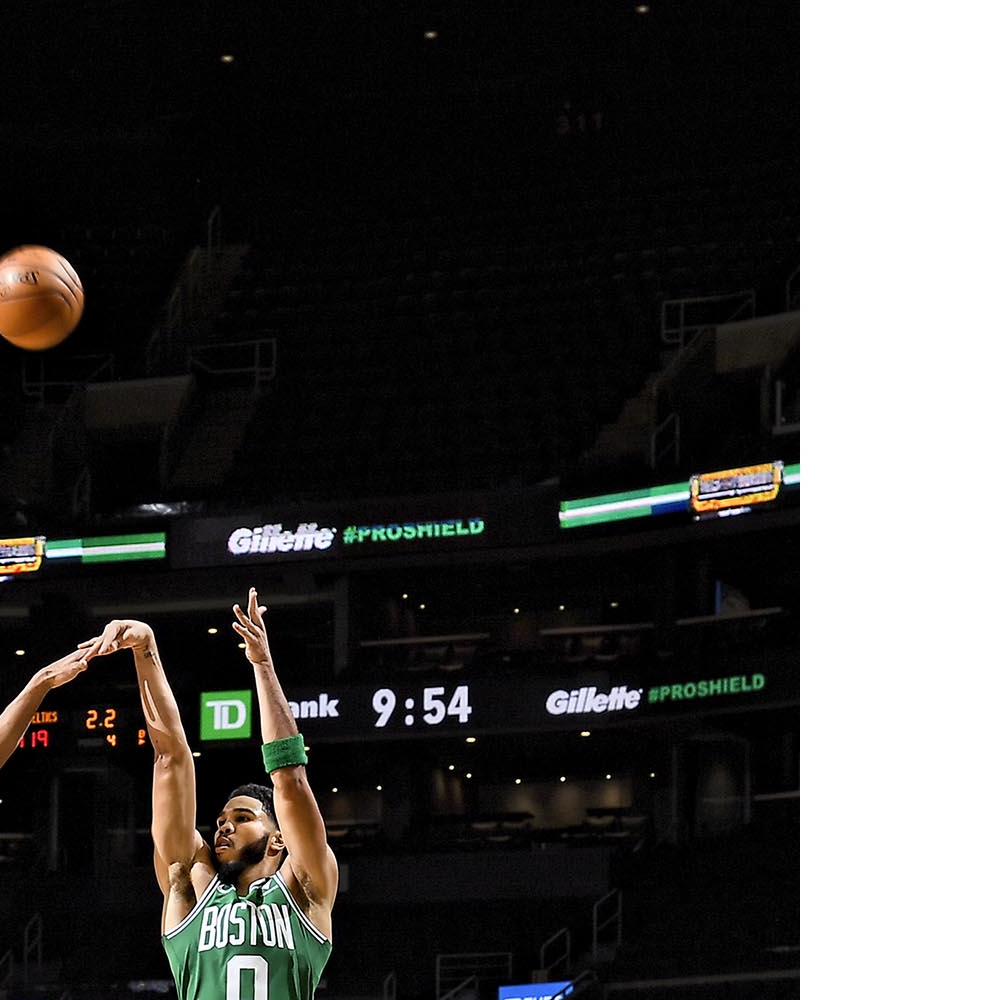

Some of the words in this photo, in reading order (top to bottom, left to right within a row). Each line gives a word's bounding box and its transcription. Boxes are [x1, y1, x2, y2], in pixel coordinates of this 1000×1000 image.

[228, 523, 334, 555] Gillette
[343, 518, 485, 544] #PROSHIELD
[206, 699, 247, 730] TD
[288, 693, 340, 719] ank
[372, 685, 472, 728] 9:54
[546, 685, 640, 715] Gillette
[648, 673, 766, 703] #PROSHIELD
[86, 709, 117, 729] 2.2
[106, 734, 117, 747] 4
[198, 901, 295, 953] BOSTON
